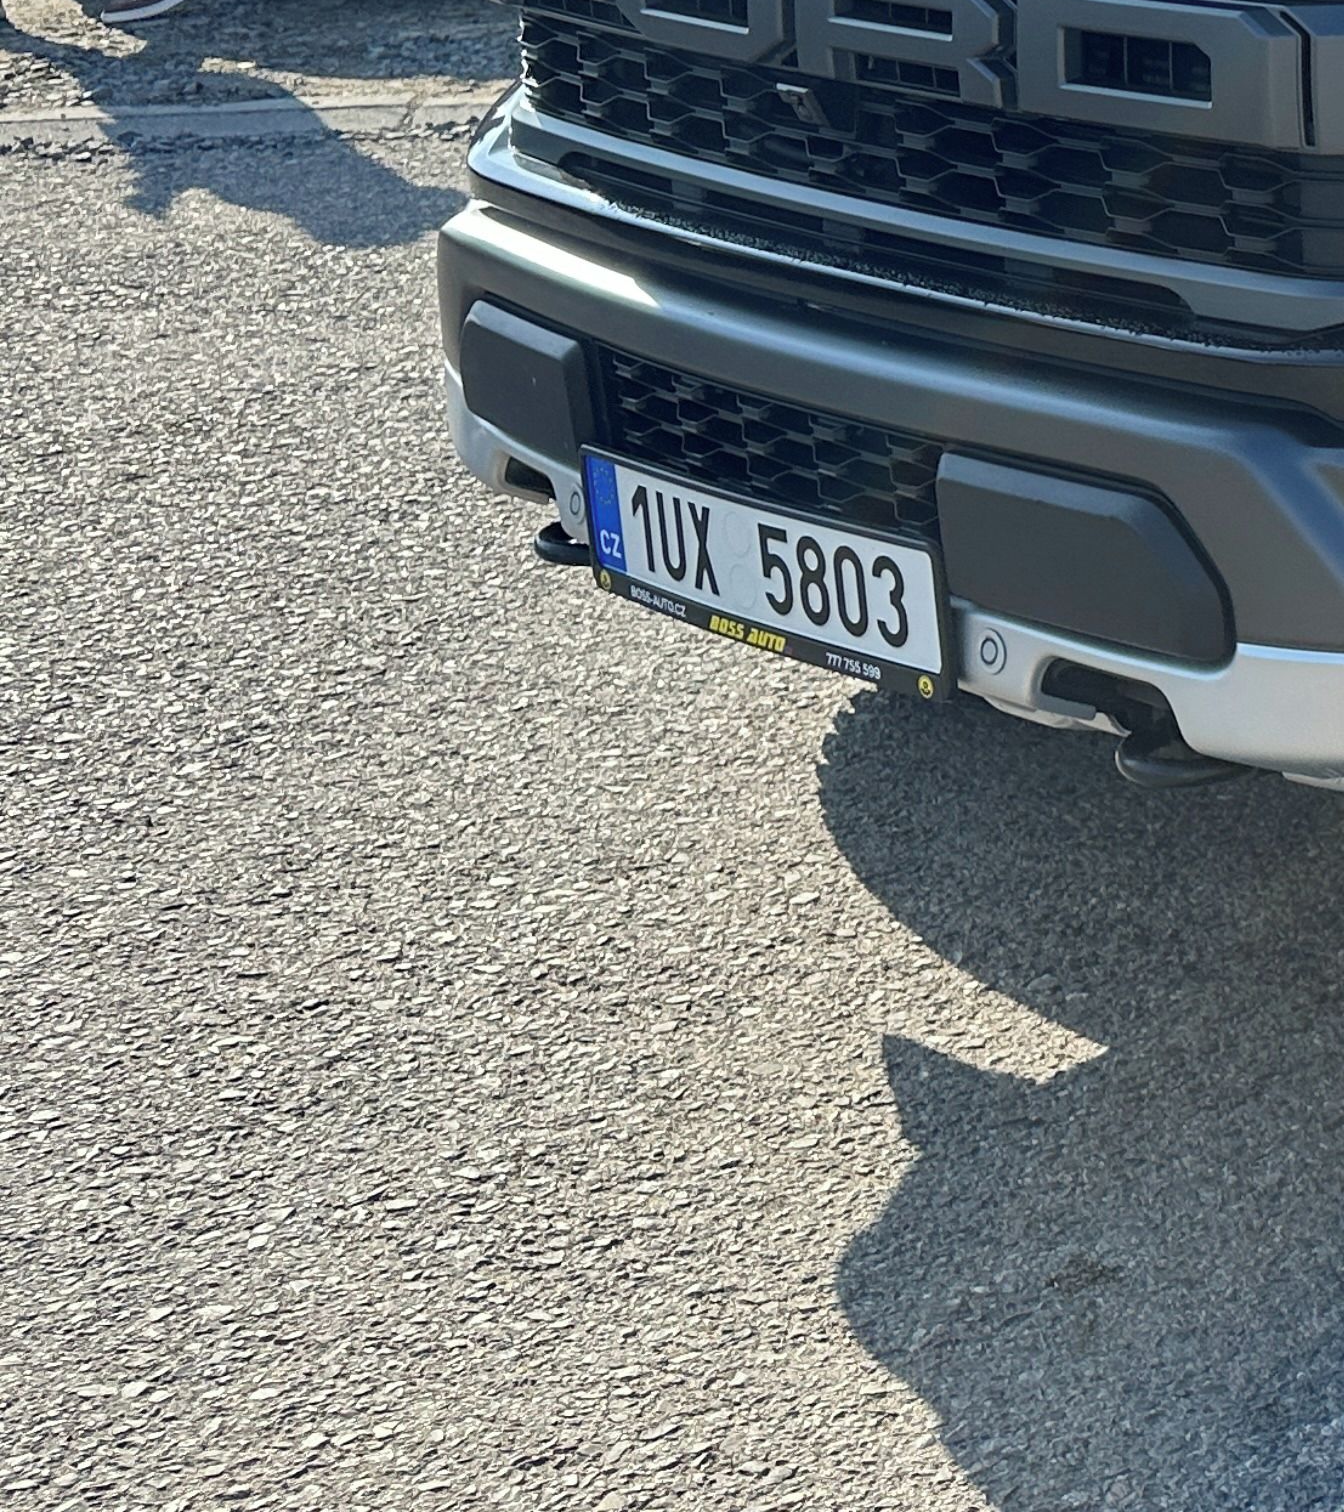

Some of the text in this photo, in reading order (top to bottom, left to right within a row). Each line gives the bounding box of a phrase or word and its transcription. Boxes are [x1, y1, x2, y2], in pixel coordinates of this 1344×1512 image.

[600, 529, 622, 558] CZ
[631, 485, 909, 648] 1UX 5803
[630, 585, 687, 618] BOSS-AUTO.CZ
[710, 615, 786, 652] BOSS AUTO
[843, 657, 861, 674] 755
